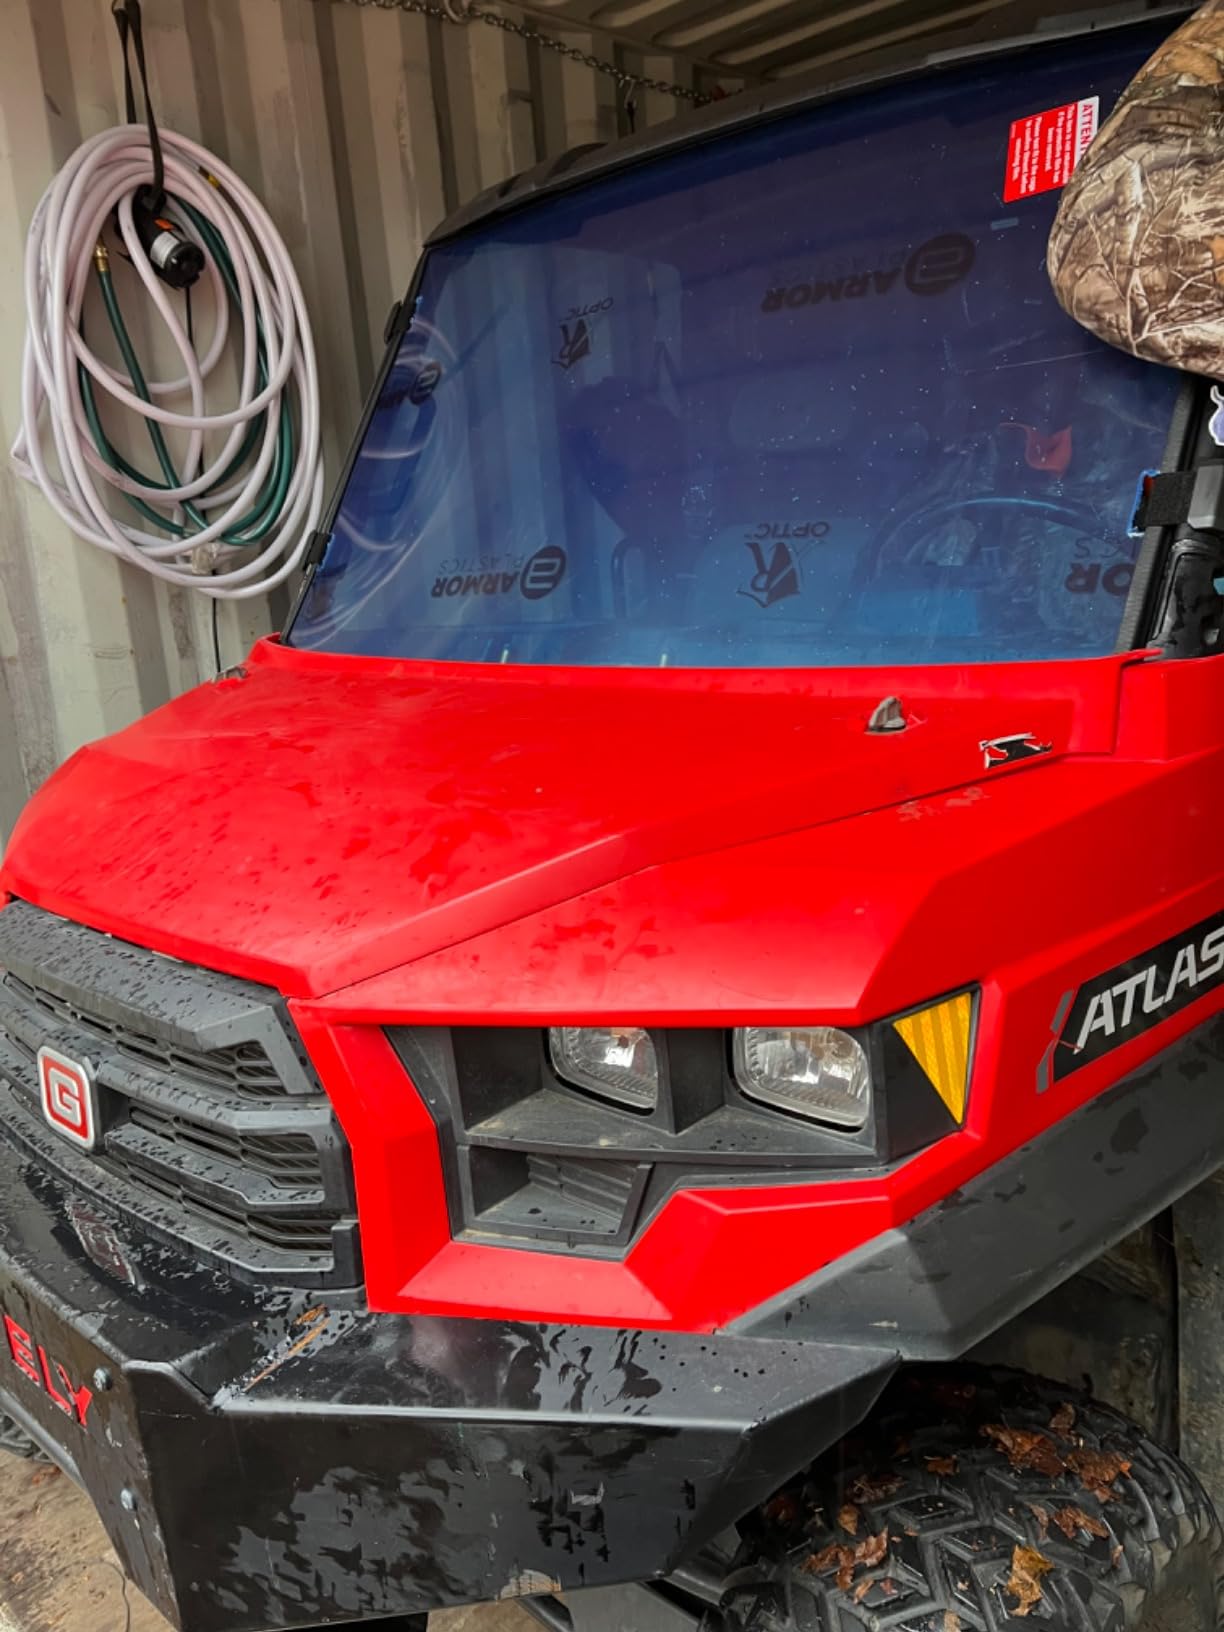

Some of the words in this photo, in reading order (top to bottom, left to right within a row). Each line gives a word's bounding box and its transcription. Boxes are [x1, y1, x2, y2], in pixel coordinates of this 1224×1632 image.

[762, 267, 903, 313] ARMOR
[430, 571, 521, 598] ARMOR
[1073, 925, 1224, 1056] ATLAS
